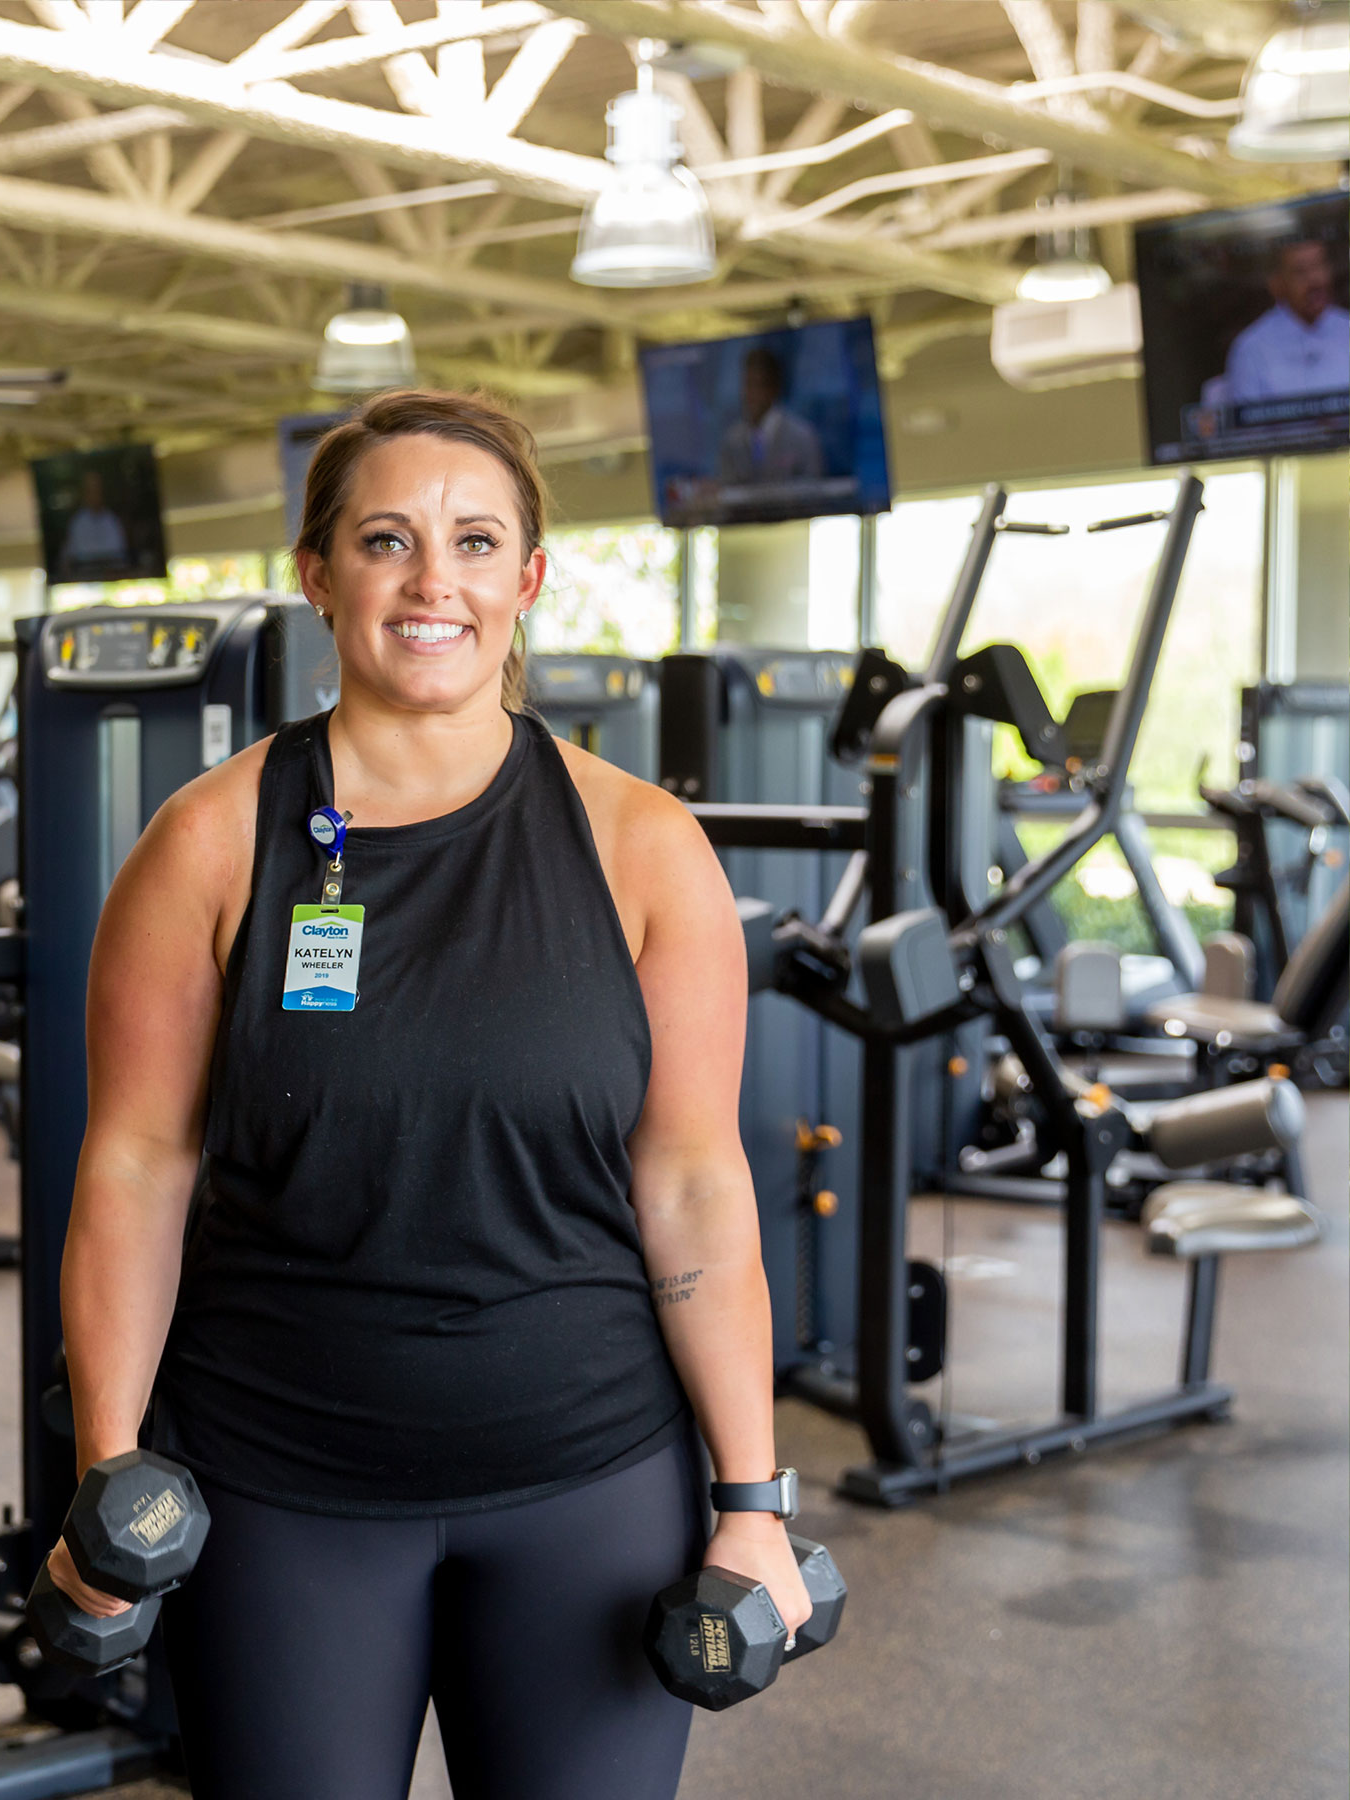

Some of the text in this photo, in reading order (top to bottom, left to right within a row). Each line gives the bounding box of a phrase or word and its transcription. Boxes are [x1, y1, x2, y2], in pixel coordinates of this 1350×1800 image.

[313, 826, 333, 834] Clayton
[302, 925, 348, 938] Clayton
[294, 948, 353, 959] KATELYN
[301, 962, 343, 970] WHEELER
[689, 1633, 700, 1656] 12LB
[703, 1618, 718, 1666] SYSTEMS
[714, 1619, 728, 1667] POWER
